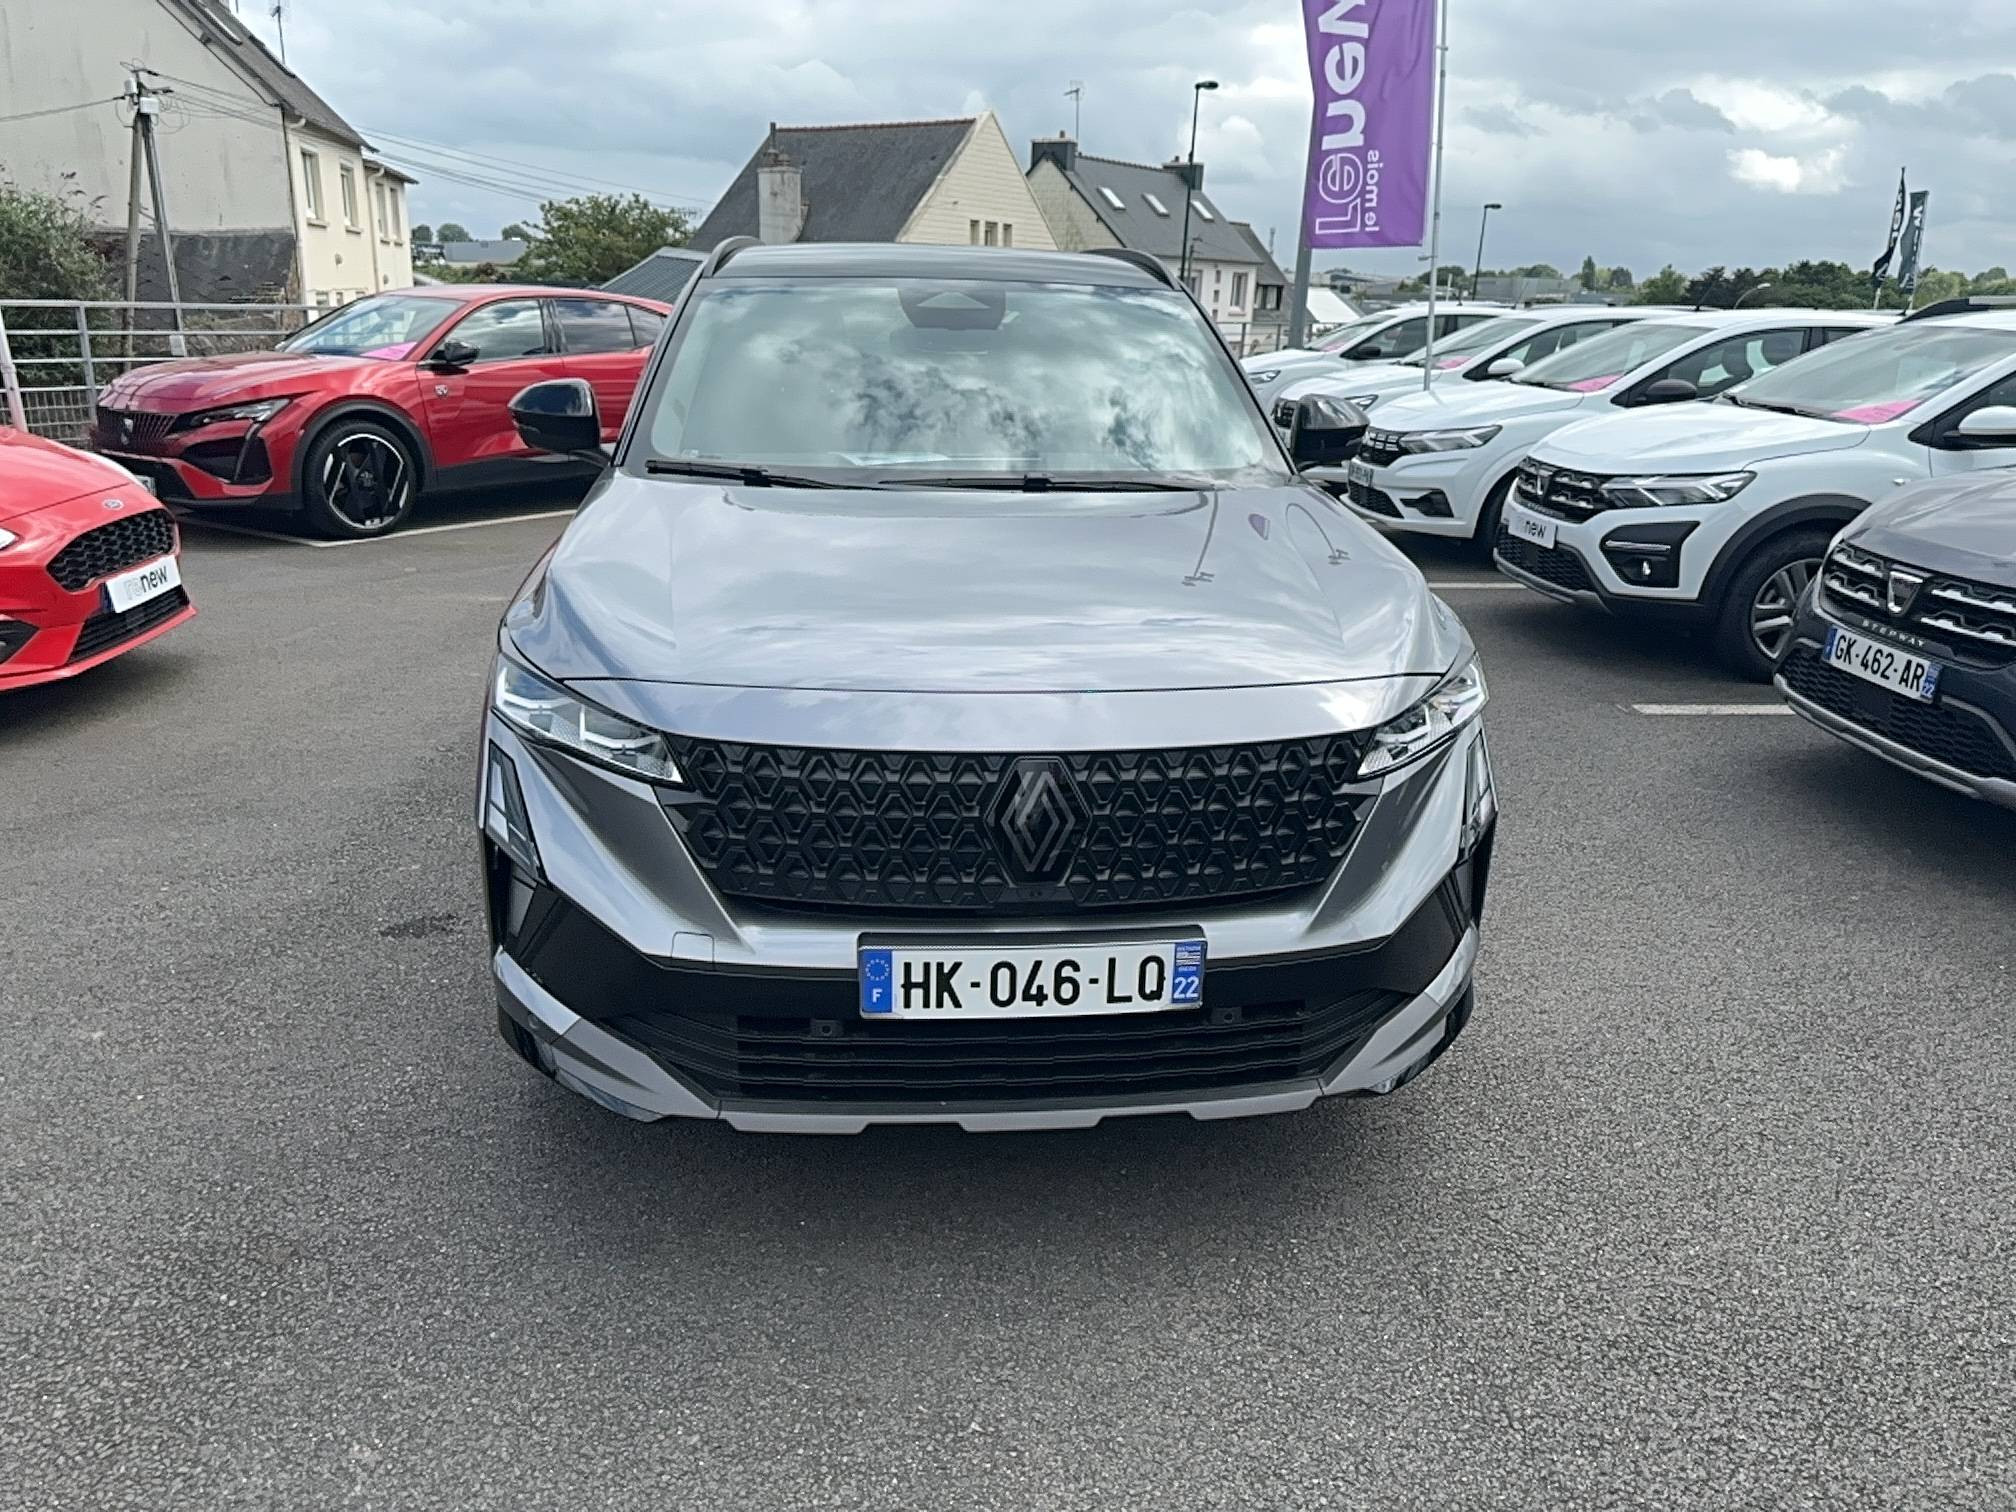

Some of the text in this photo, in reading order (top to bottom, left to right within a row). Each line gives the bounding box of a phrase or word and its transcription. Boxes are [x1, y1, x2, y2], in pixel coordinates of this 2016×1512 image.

[1834, 634, 1925, 692] GK-462-AR
[872, 988, 883, 1003] F
[1173, 975, 1200, 999] 22
